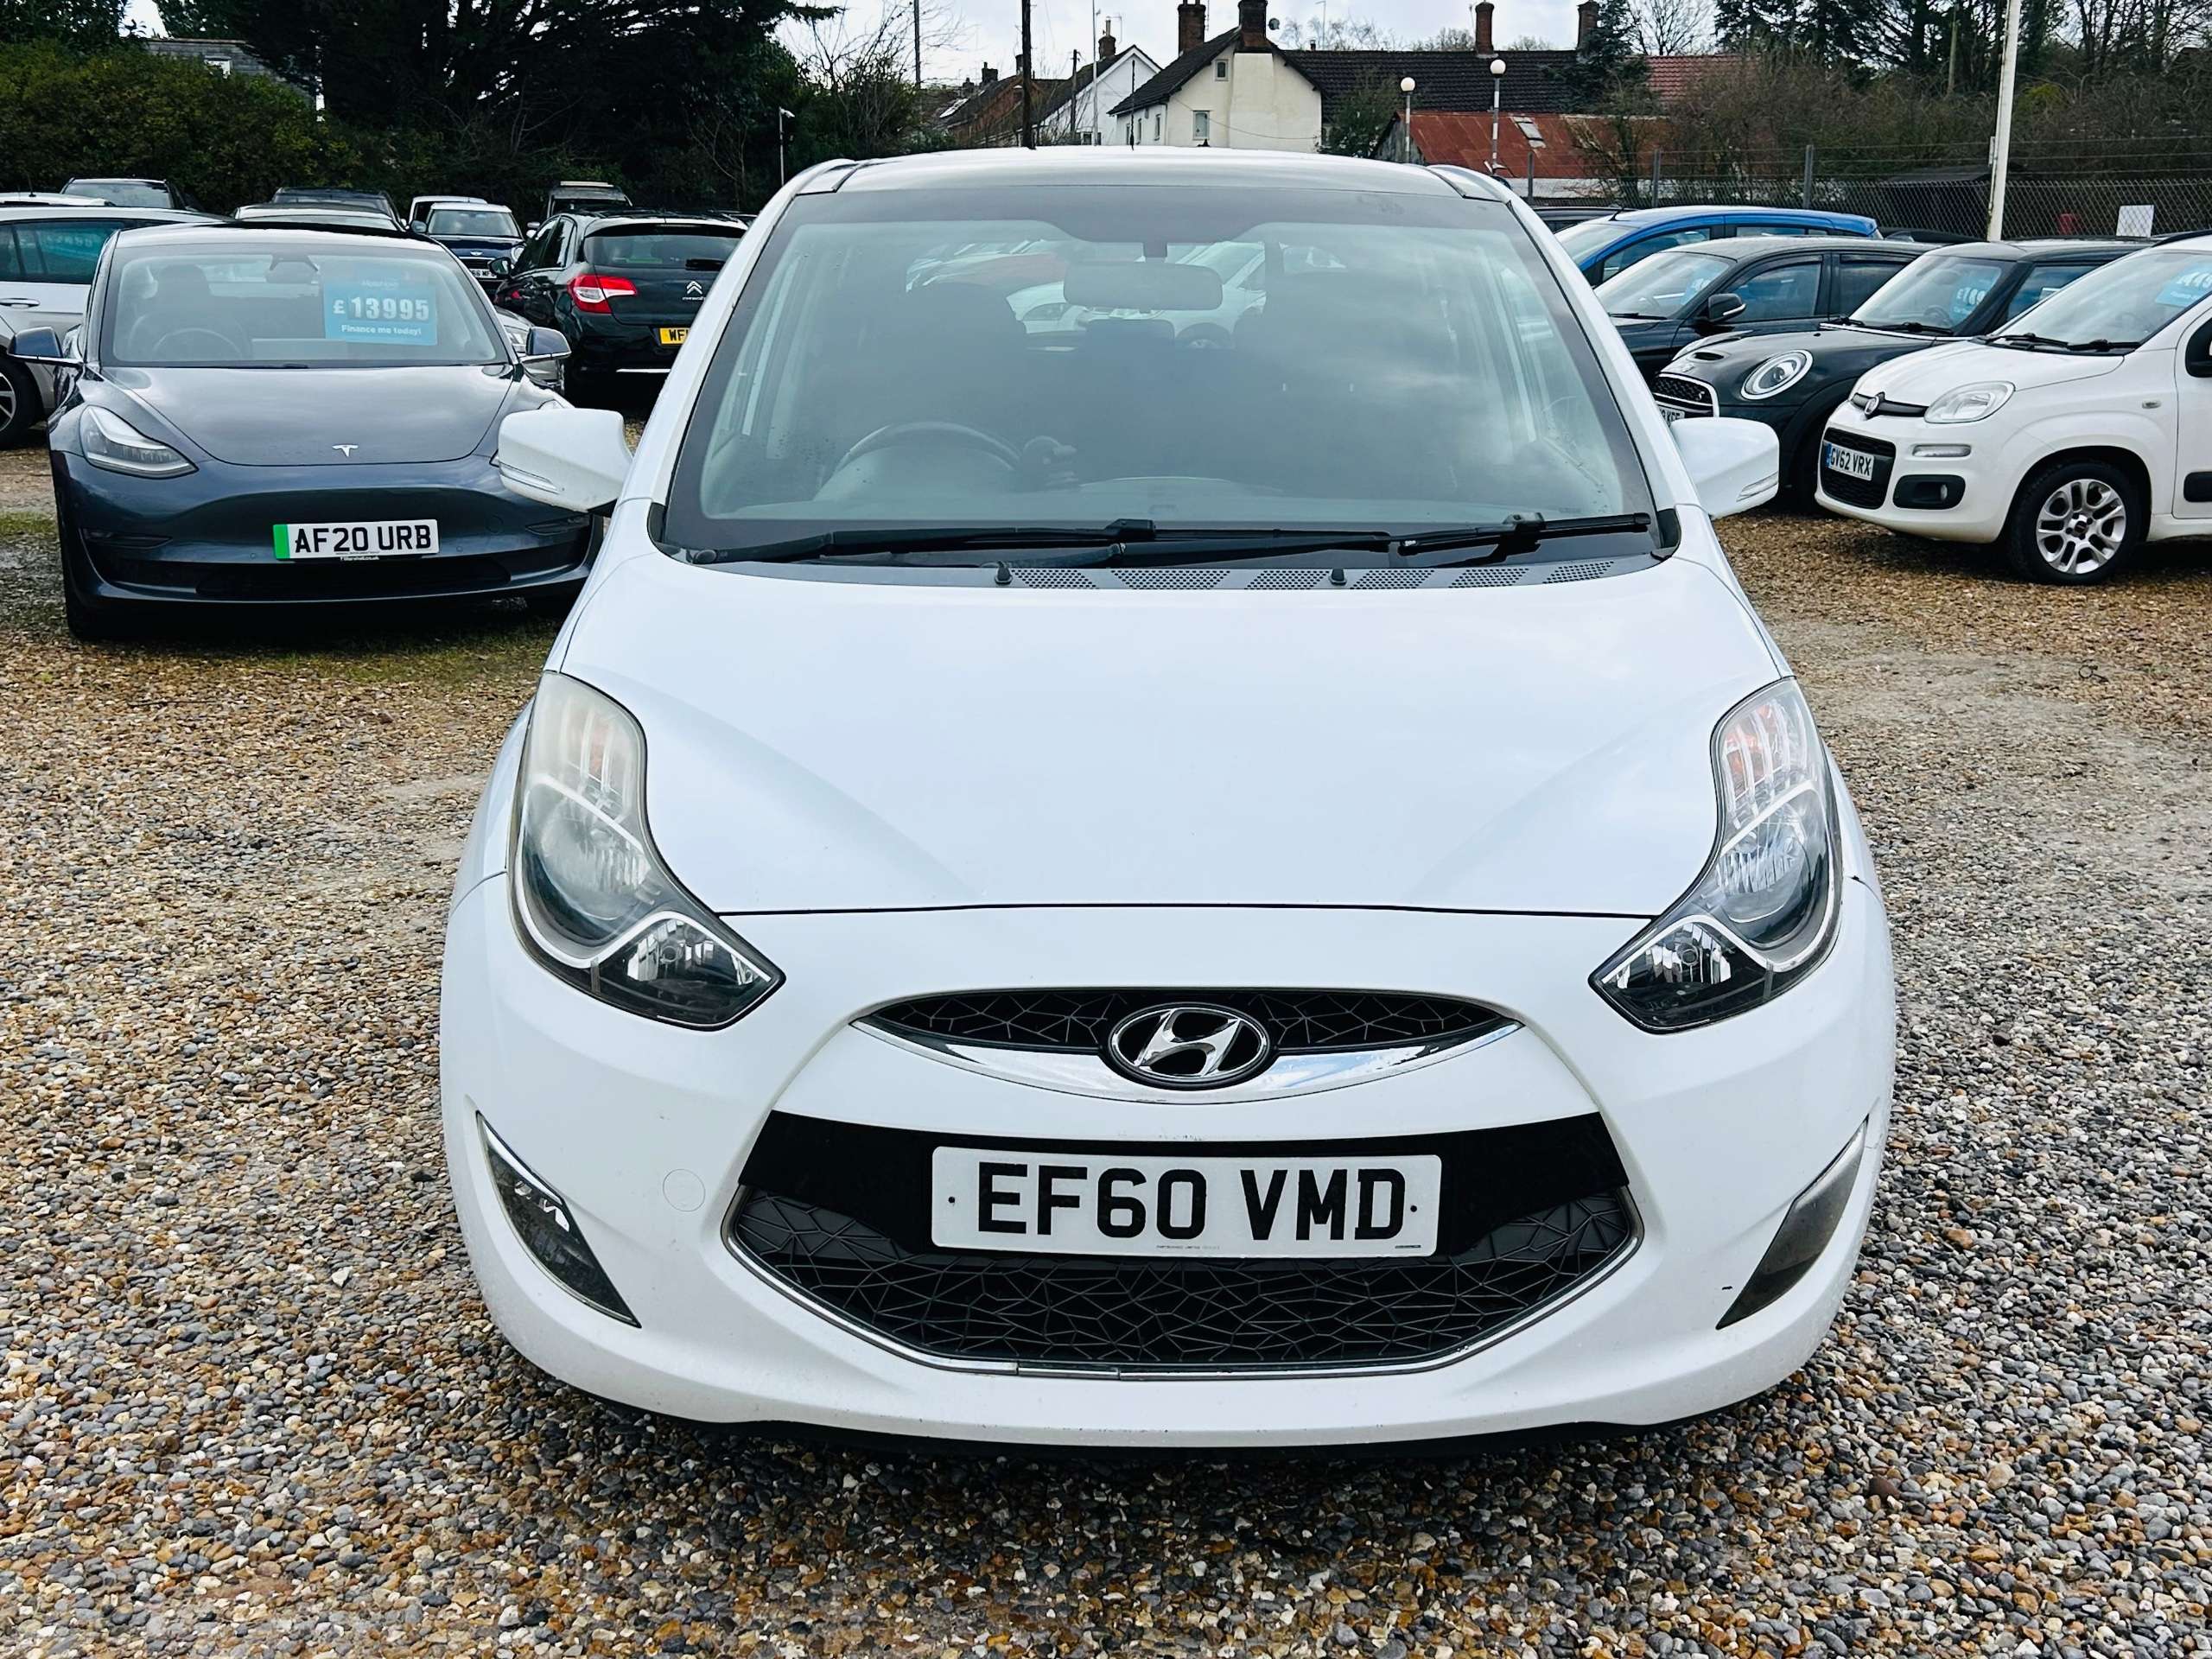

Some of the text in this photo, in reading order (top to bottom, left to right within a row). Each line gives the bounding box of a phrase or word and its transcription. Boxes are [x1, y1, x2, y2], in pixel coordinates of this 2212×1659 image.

[340, 324, 377, 334] Finance
[1853, 453, 1872, 476] VRX
[295, 524, 431, 553] AF20 URB
[978, 1161, 1406, 1241] EF60 VMD
